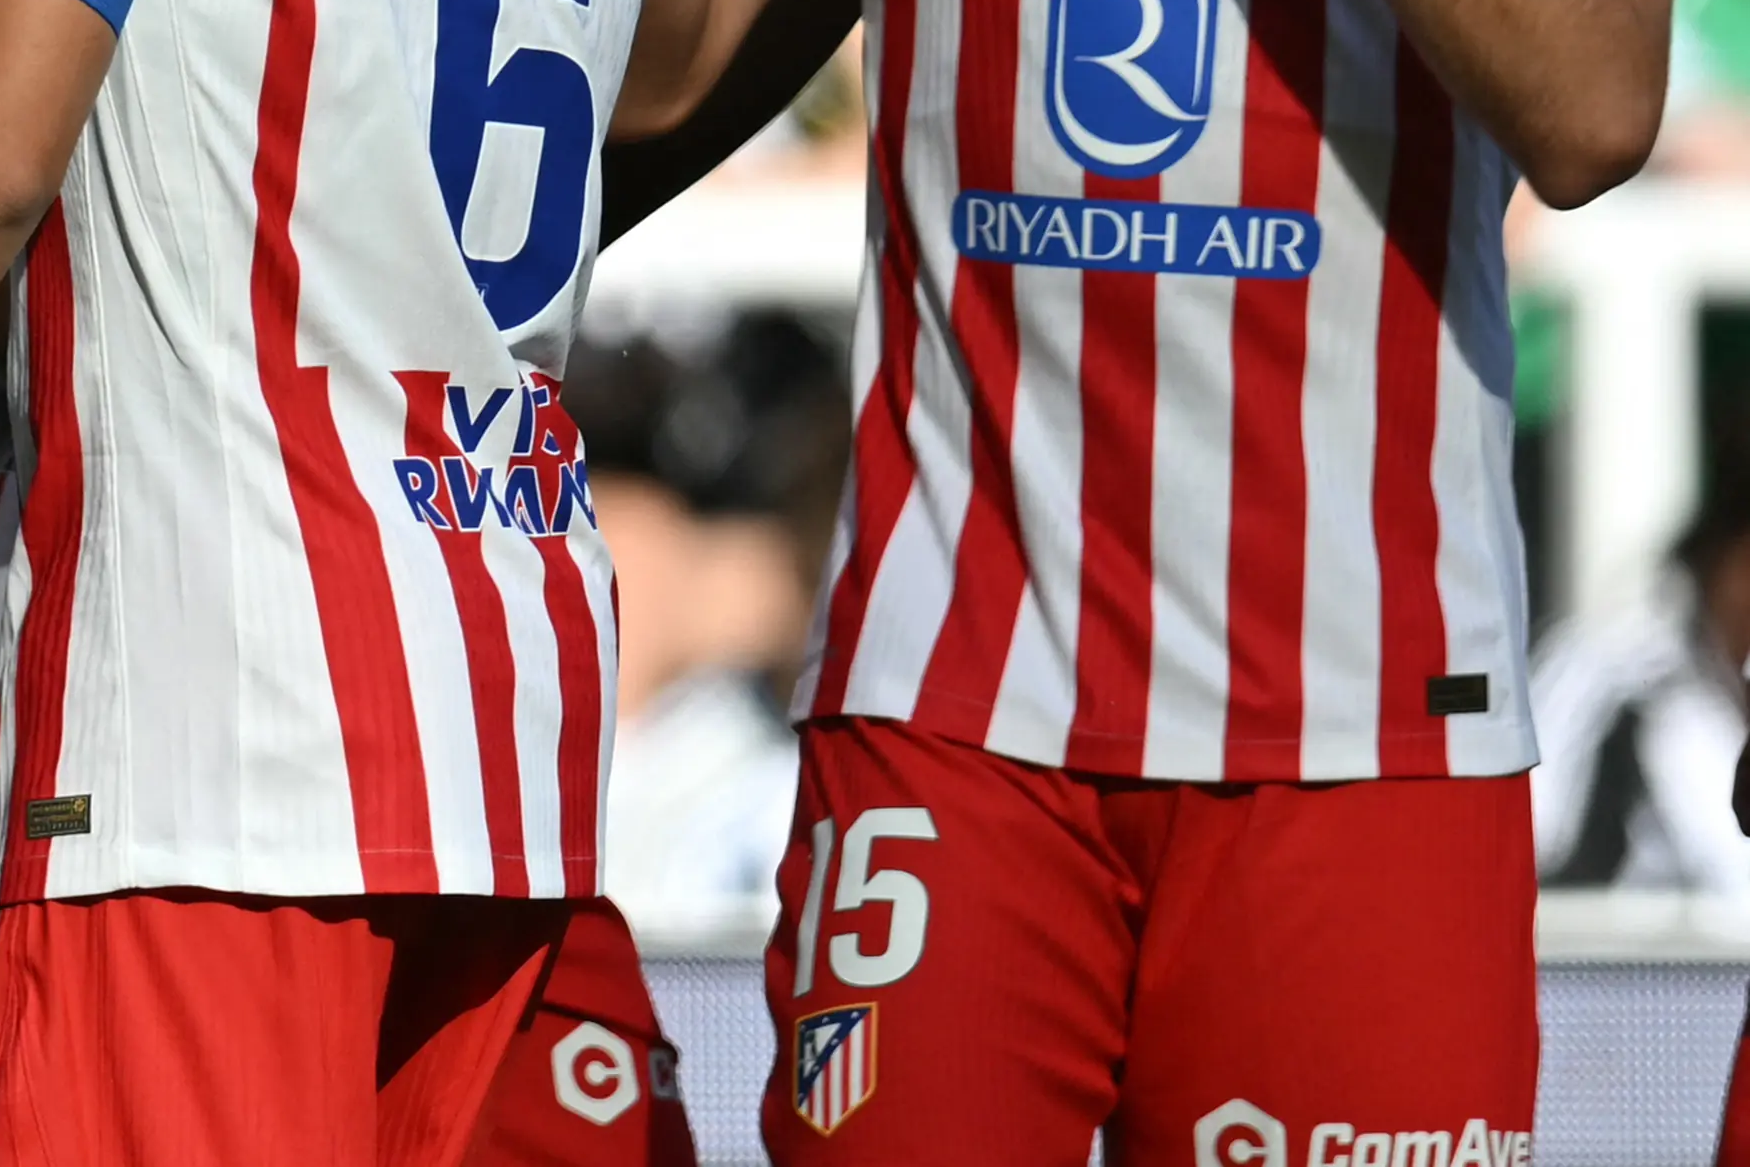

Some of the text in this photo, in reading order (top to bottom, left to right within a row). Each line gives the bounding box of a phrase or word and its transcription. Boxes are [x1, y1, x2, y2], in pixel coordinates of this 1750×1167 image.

[965, 199, 1306, 271] RIYADH AIR
[793, 807, 940, 999] 15
